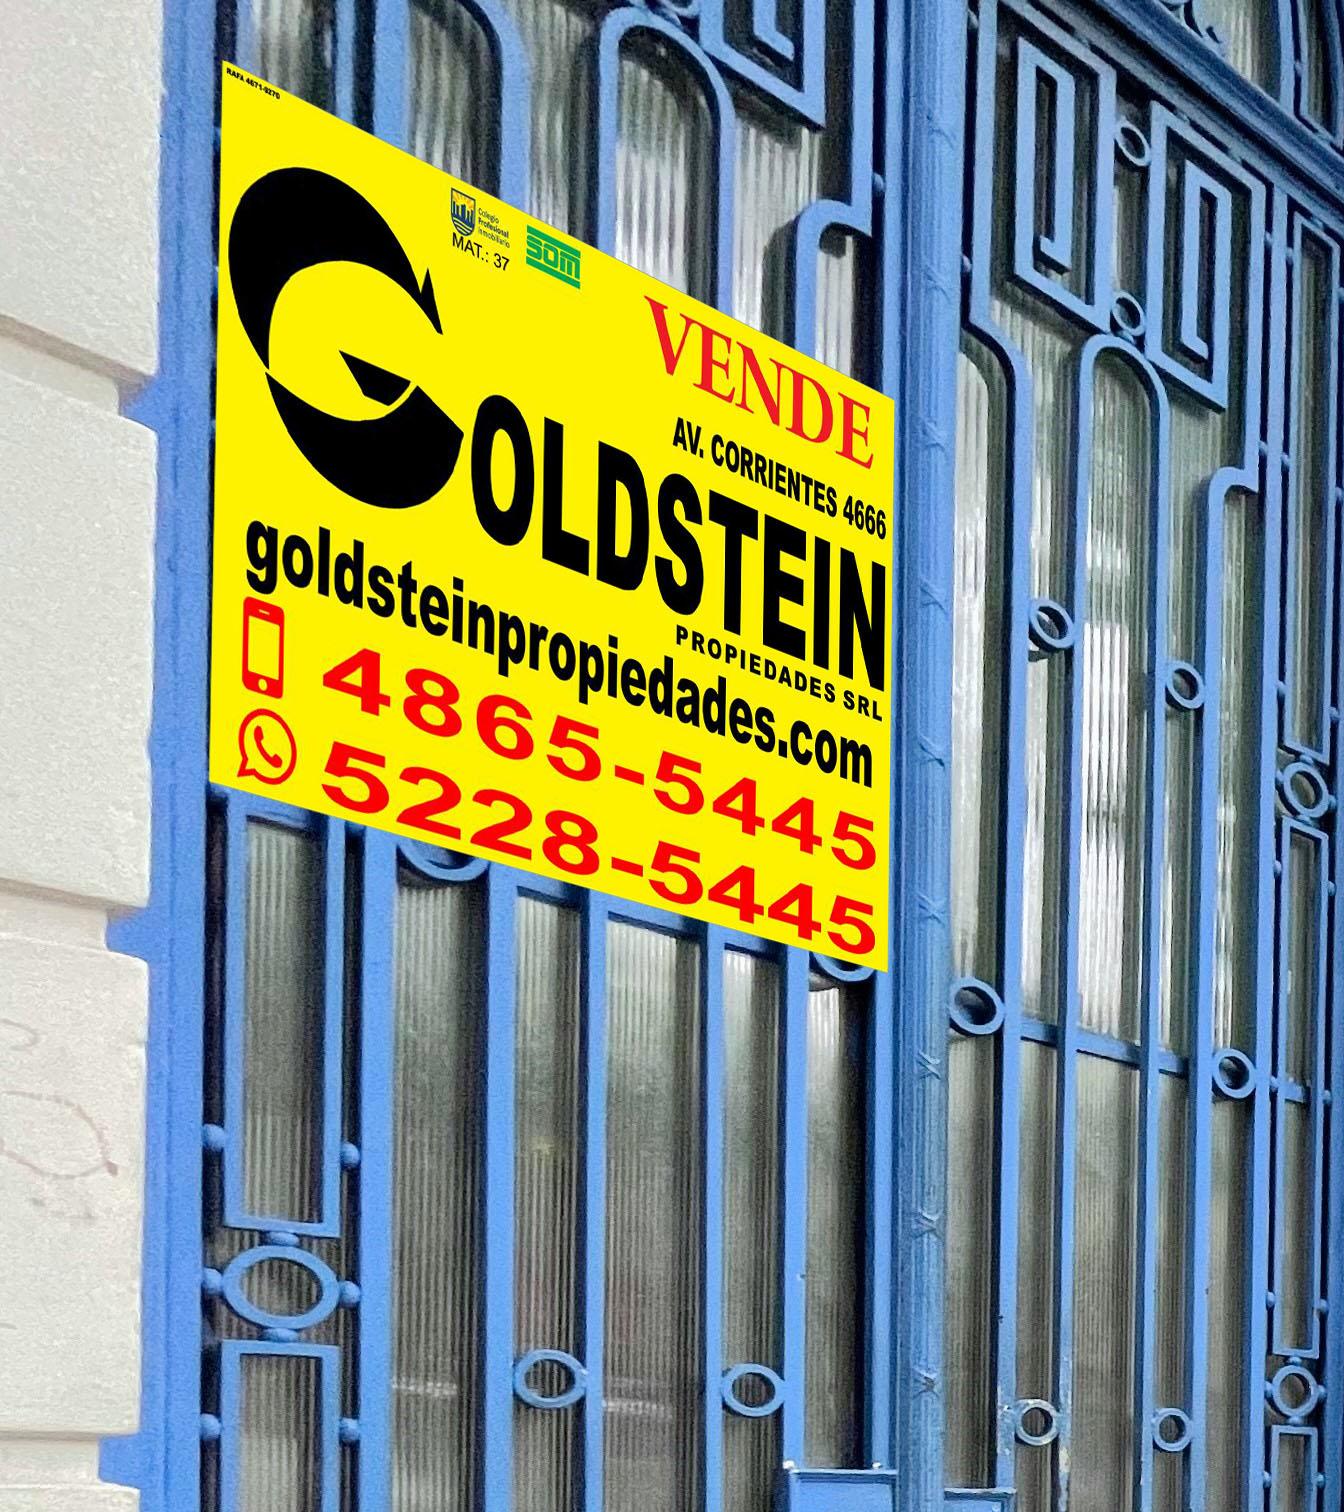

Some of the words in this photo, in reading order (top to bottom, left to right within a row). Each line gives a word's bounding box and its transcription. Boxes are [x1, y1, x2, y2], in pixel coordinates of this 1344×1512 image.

[226, 67, 244, 82] RAFA
[452, 232, 489, 263] MAT.:
[493, 252, 510, 271] 37
[478, 207, 500, 224] Colegio
[478, 217, 509, 238] Profesional
[478, 228, 510, 249] Inmobiliario
[228, 167, 887, 692] GOLDSTEIN
[645, 296, 874, 469] VENDE
[673, 417, 704, 459] AV.
[712, 435, 838, 518] CORRIENTES
[843, 495, 887, 540] 4666
[247, 520, 873, 788] goldsteinpropiedades.com
[677, 625, 836, 703] PROPIEDADES
[843, 690, 883, 722] SRL
[322, 648, 877, 871] 4865-5445
[321, 742, 876, 955] 5228-5445
